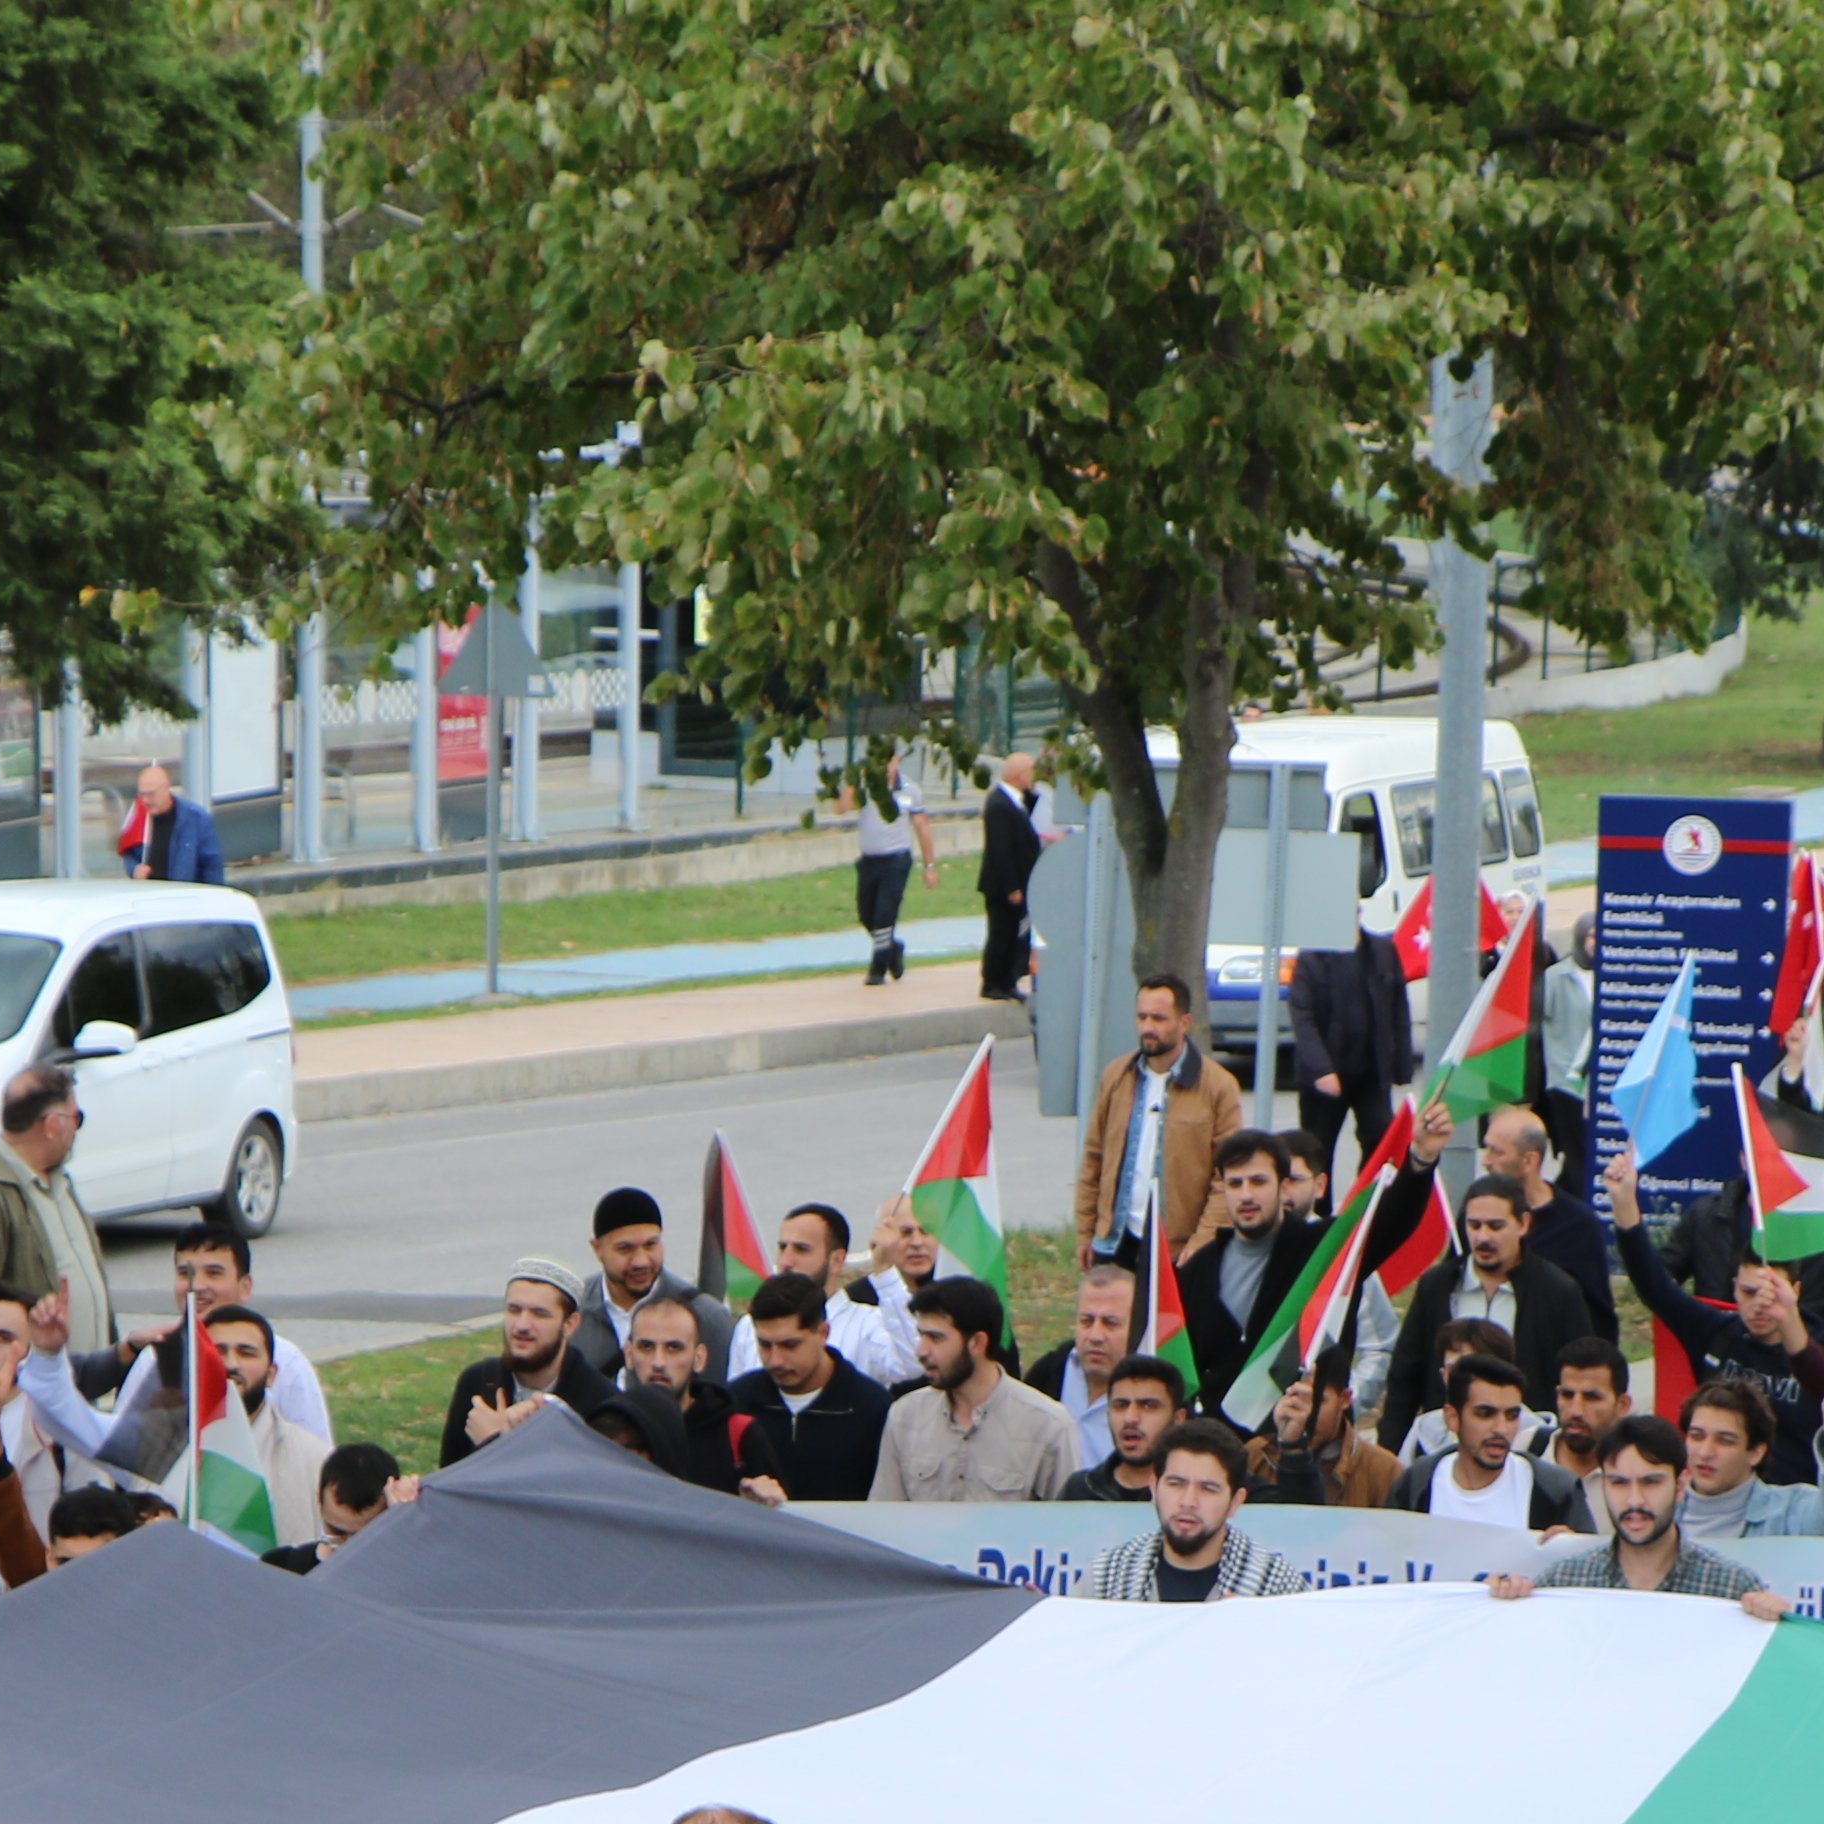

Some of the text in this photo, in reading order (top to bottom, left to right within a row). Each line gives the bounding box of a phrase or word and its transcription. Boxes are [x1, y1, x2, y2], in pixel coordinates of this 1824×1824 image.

[1603, 892, 1653, 906] Kenevir
[1603, 911, 1664, 925] Enstitüsü
[1602, 946, 1738, 962] Veterinerlik Fkültesi
[1695, 1023, 1754, 1039] Teknoloji
[1693, 1041, 1750, 1056] ygulama
[1639, 1173, 1689, 1190] Öğrenci
